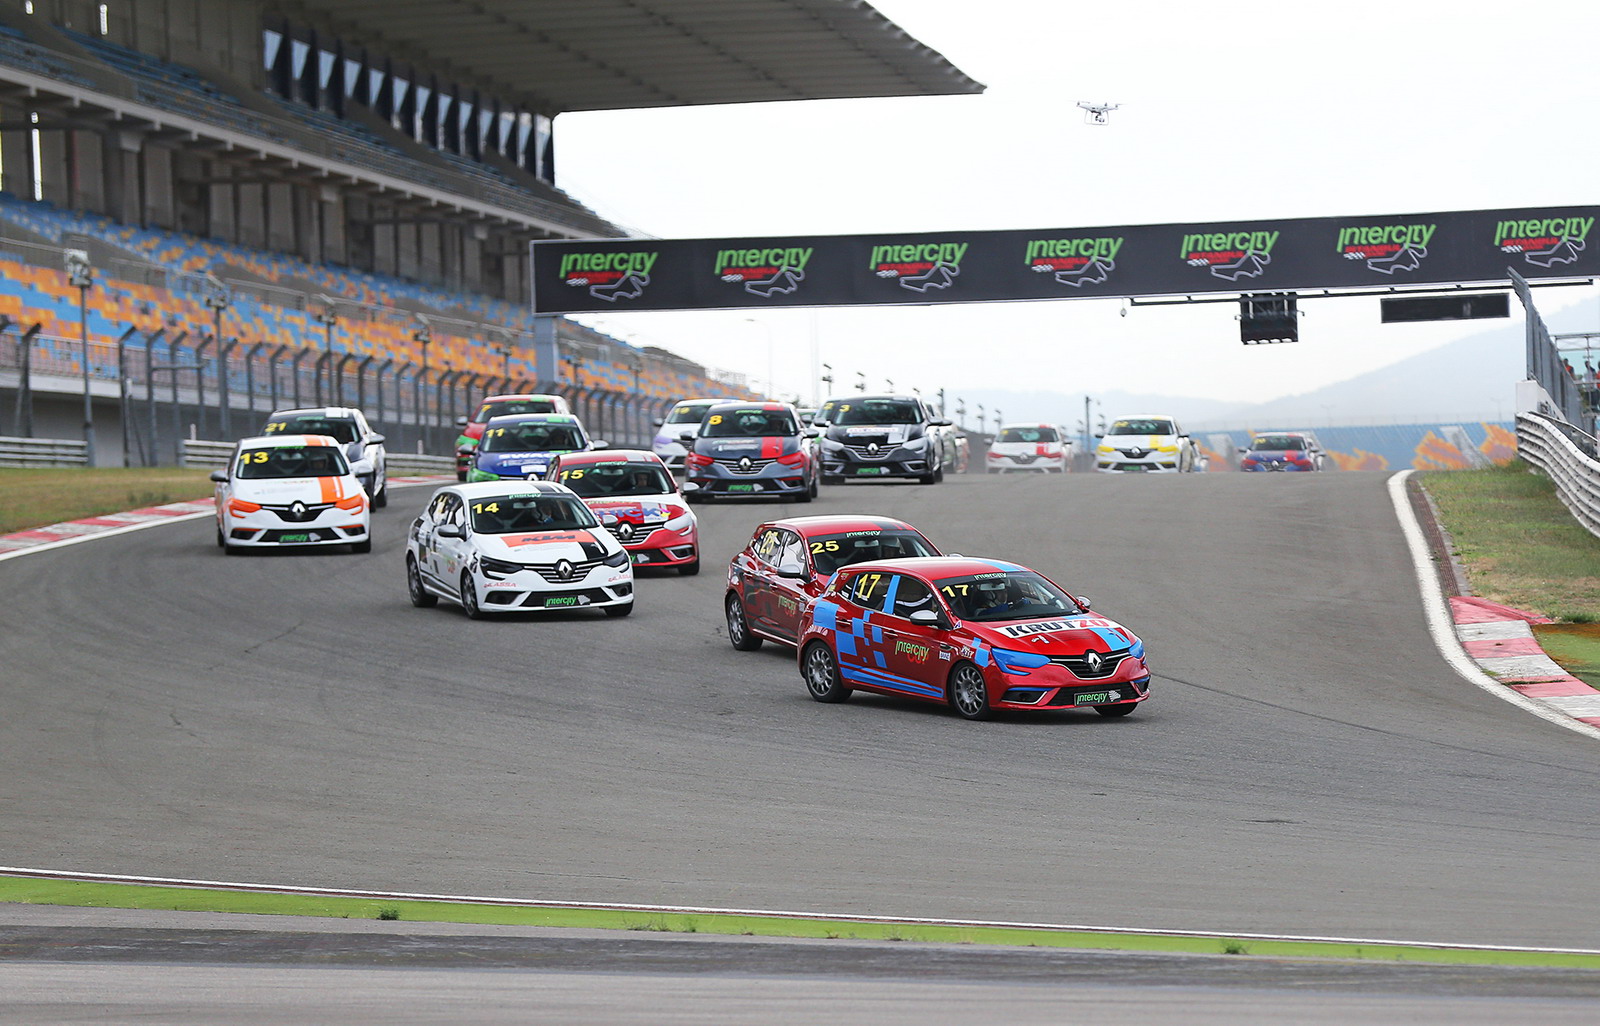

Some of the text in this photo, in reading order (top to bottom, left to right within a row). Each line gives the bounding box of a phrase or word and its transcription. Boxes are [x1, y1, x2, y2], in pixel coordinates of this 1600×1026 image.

[708, 415, 722, 425] 8
[264, 422, 287, 432] 21
[485, 427, 505, 438] 11
[240, 451, 268, 464] 13
[560, 469, 584, 480] 15
[472, 502, 500, 514] 14
[760, 530, 779, 554] 25
[810, 540, 840, 555] 25
[858, 573, 881, 598] 17
[942, 584, 969, 598] 17
